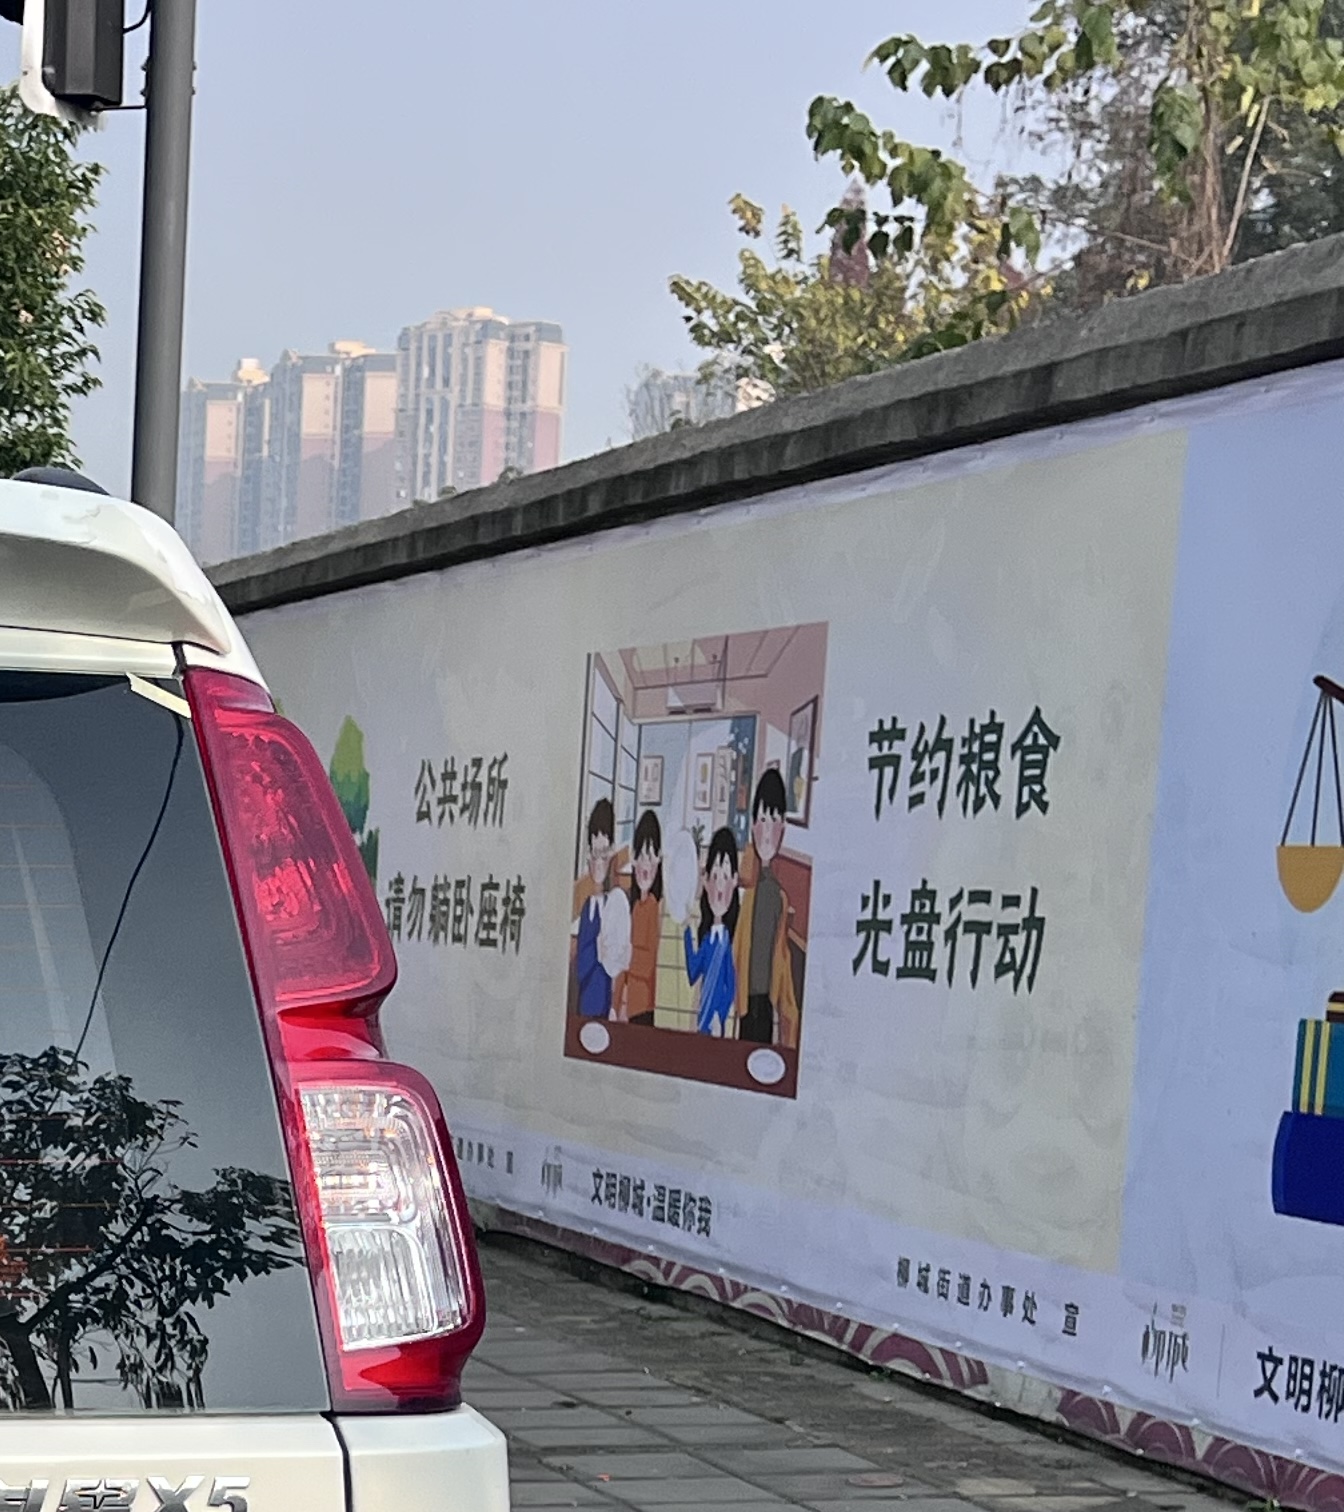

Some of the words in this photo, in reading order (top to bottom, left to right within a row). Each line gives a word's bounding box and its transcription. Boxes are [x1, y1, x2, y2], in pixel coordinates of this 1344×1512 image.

[414, 751, 509, 830] 公共场所
[867, 704, 1061, 822] 节约粮食
[385, 871, 526, 956] 请勿躺卧座椅
[852, 877, 1046, 996] 光盘行动
[1062, 1301, 1080, 1337] 宣
